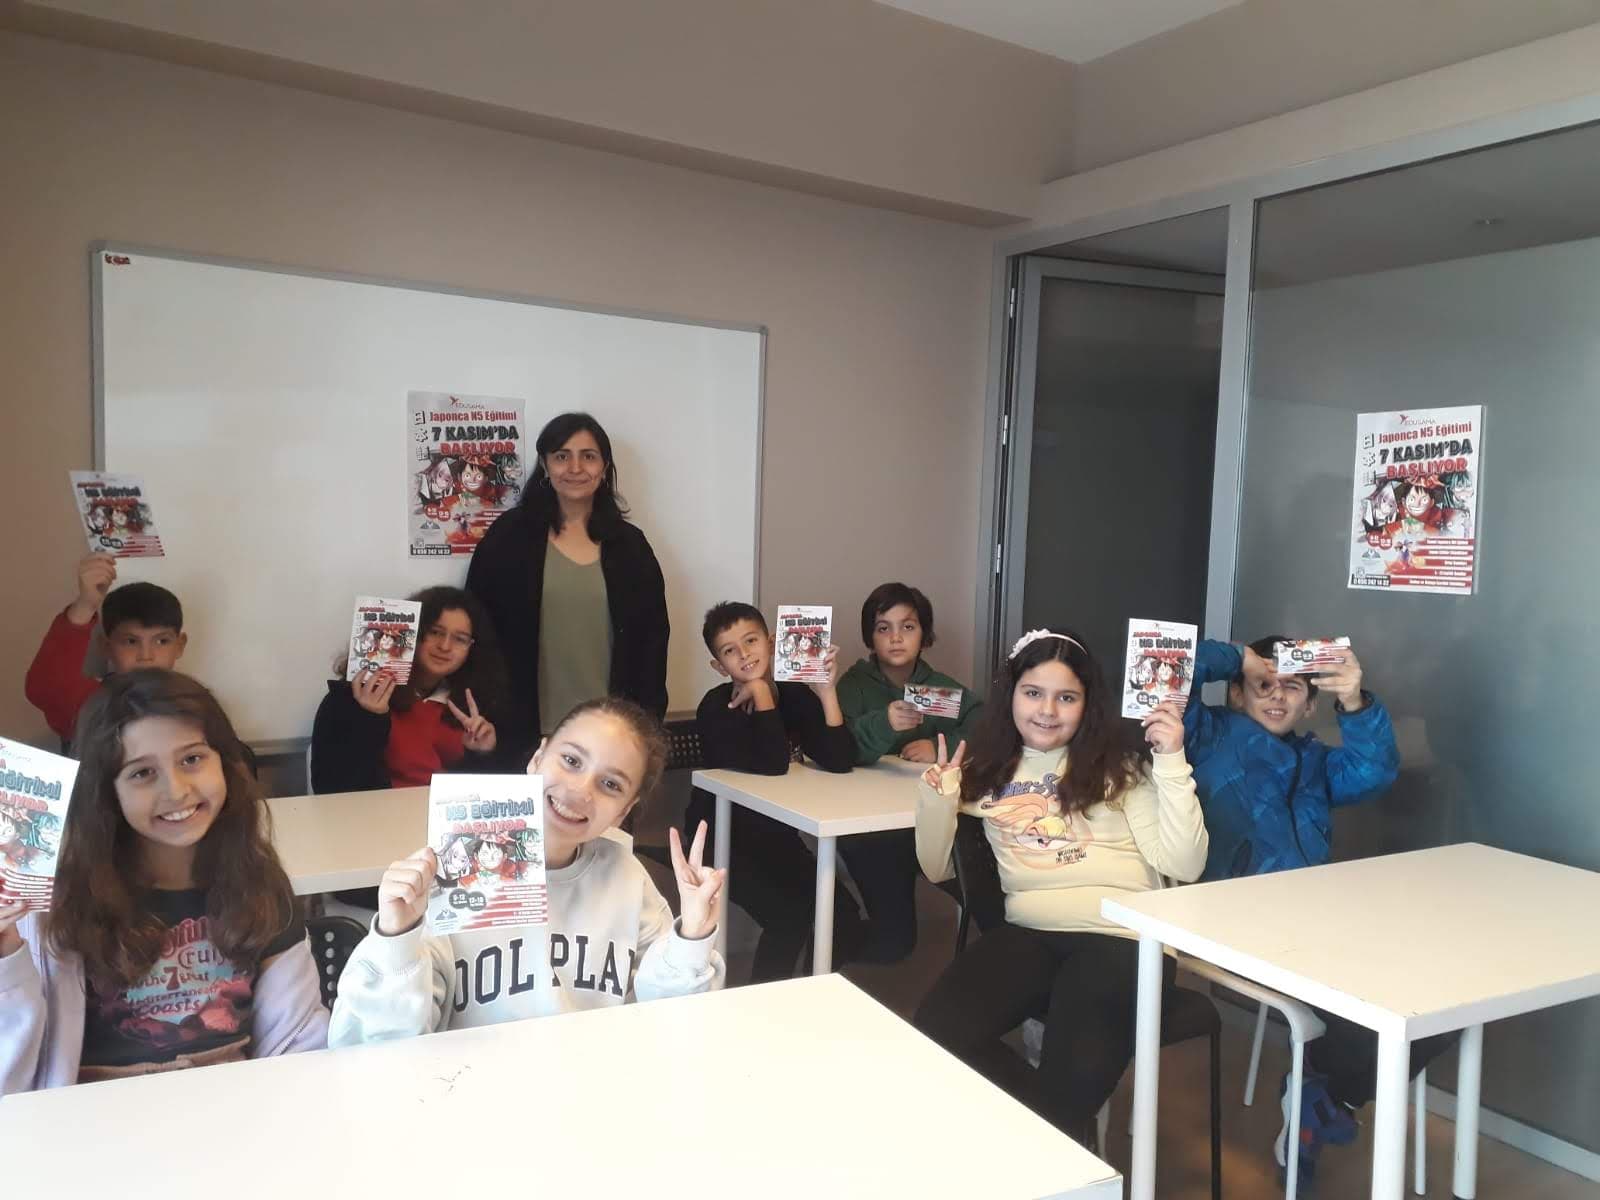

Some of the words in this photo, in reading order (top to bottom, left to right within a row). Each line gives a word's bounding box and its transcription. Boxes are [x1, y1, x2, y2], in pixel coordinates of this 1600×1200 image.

[430, 411, 468, 423] Japonca
[471, 411, 484, 421] N5
[432, 426, 442, 441] 7
[445, 425, 519, 441] KASIM'DA
[1378, 432, 1419, 444] Japonca
[1420, 427, 1434, 438] N5
[1435, 421, 1472, 437] Eğitimi
[1380, 448, 1390, 465] 7
[1393, 438, 1474, 463] KASIM'DA
[1386, 457, 1468, 480] BAŞLIYOR
[550, 933, 636, 998] PLA
[163, 966, 181, 991] 7
